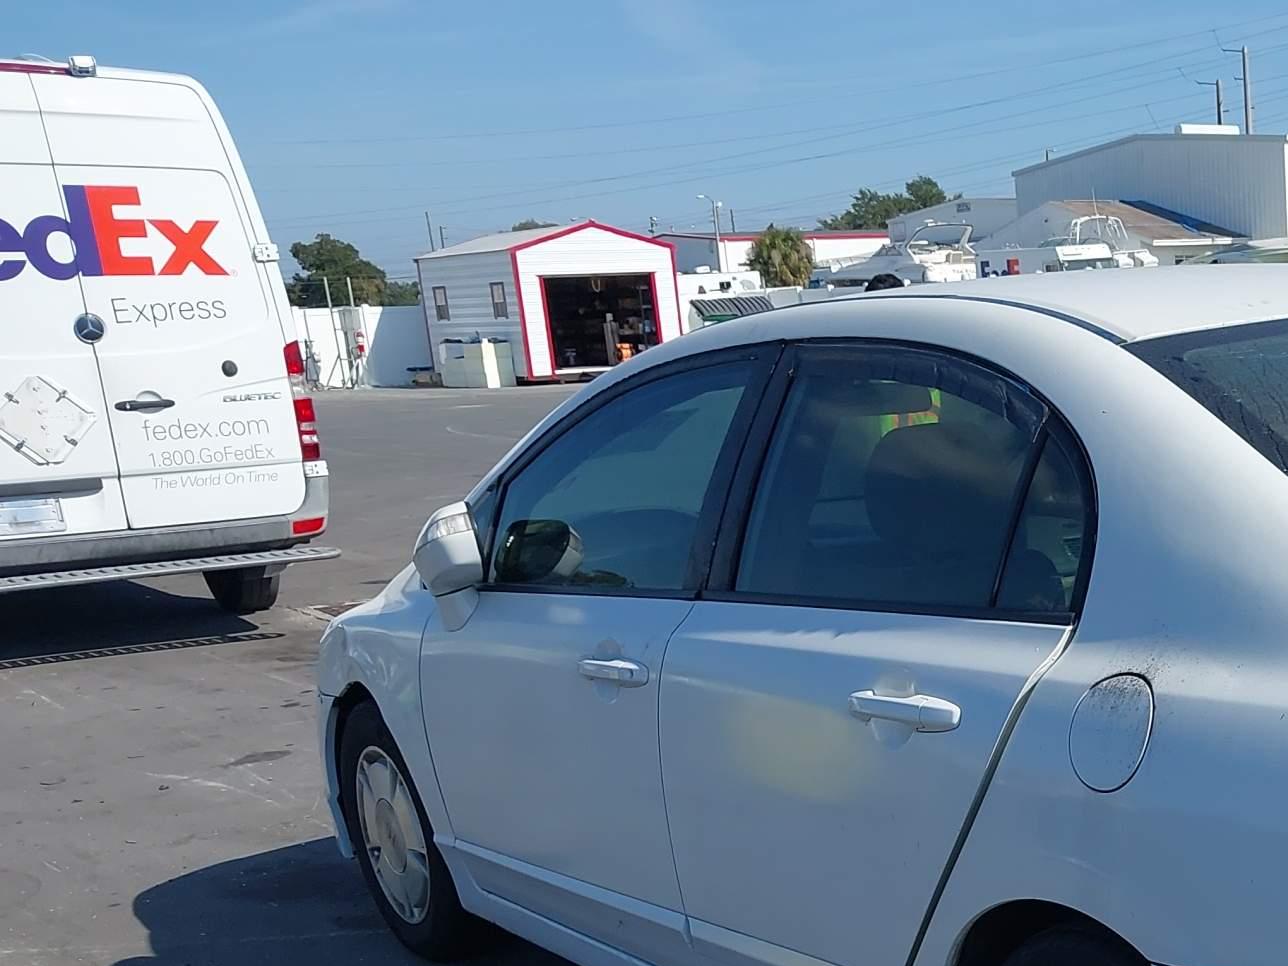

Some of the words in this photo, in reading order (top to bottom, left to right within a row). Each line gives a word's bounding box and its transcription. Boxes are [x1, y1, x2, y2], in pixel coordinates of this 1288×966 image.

[111, 297, 227, 327] Express
[142, 417, 270, 441] fedex.com
[149, 443, 275, 468] 1.800.GoFedEx
[152, 476, 177, 490] The
[180, 473, 221, 488] World
[224, 472, 244, 485] On
[248, 470, 279, 483] Time
